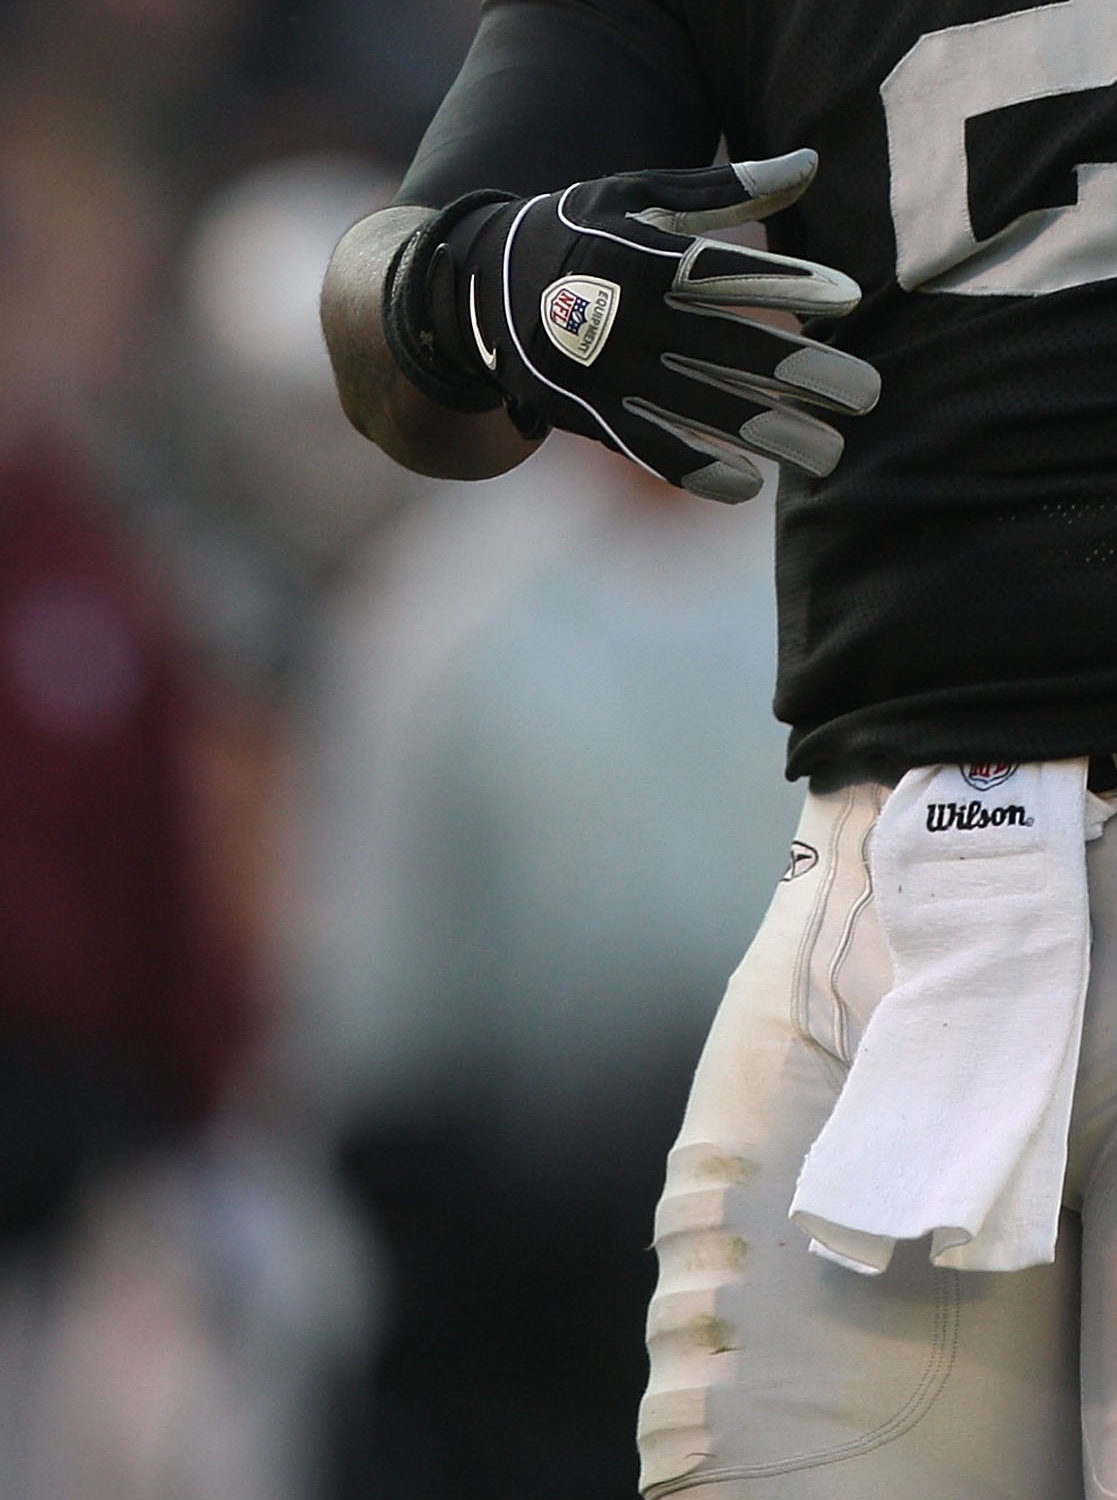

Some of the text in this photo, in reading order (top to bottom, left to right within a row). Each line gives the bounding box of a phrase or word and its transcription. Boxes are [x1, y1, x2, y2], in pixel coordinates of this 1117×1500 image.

[552, 292, 575, 323] NFL
[577, 290, 609, 354] EQUIPMENT
[926, 800, 1026, 832] Wilson
